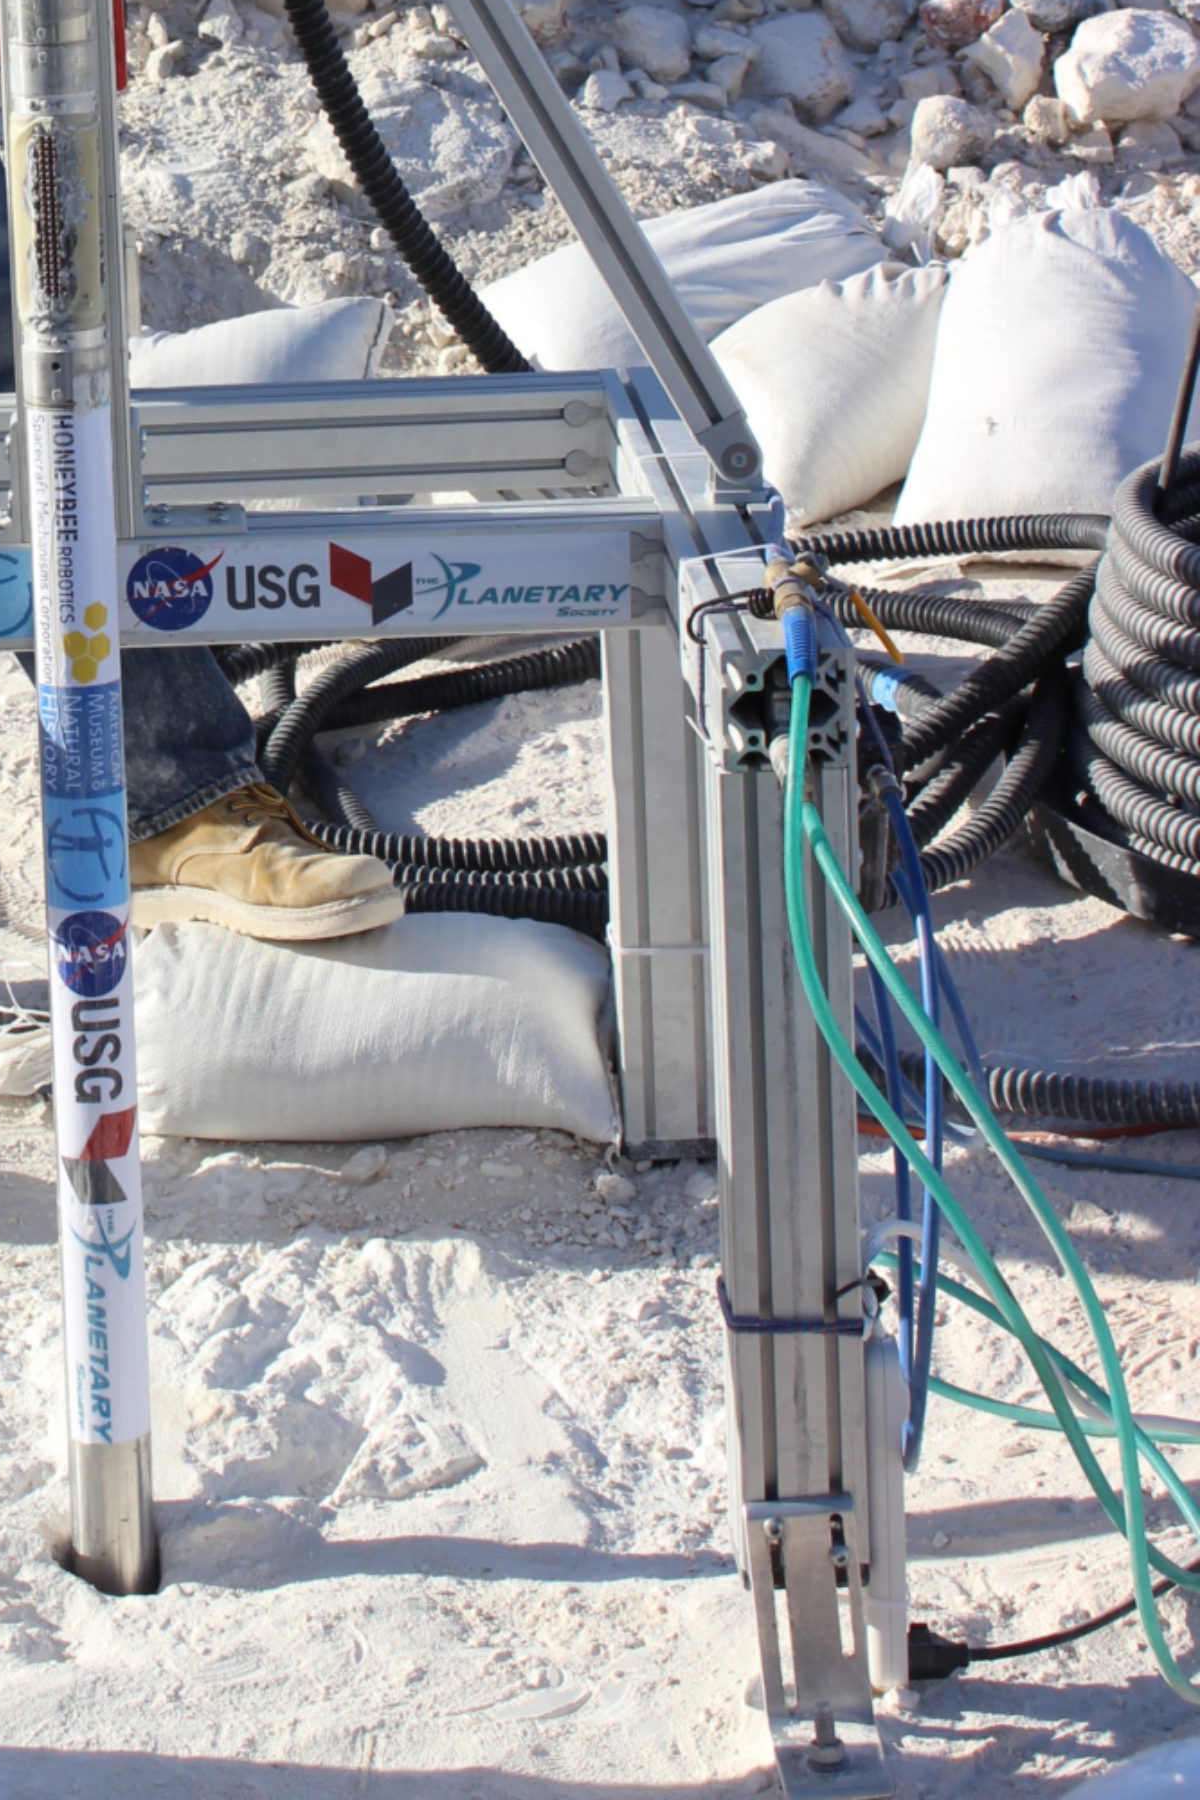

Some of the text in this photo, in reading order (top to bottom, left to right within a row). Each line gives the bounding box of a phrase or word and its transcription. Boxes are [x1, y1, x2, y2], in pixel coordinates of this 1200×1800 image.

[52, 414, 78, 624] HONEYBEE ROBOTICS
[32, 414, 54, 684] Spacecraft Mechanisms Corporation
[133, 579, 208, 598] NASA
[226, 564, 321, 610] USG
[415, 577, 439, 585] THE
[556, 606, 619, 618] SOCIETY
[88, 693, 104, 777] MUSEUM
[57, 941, 125, 963] NASA
[71, 997, 123, 1103] USG
